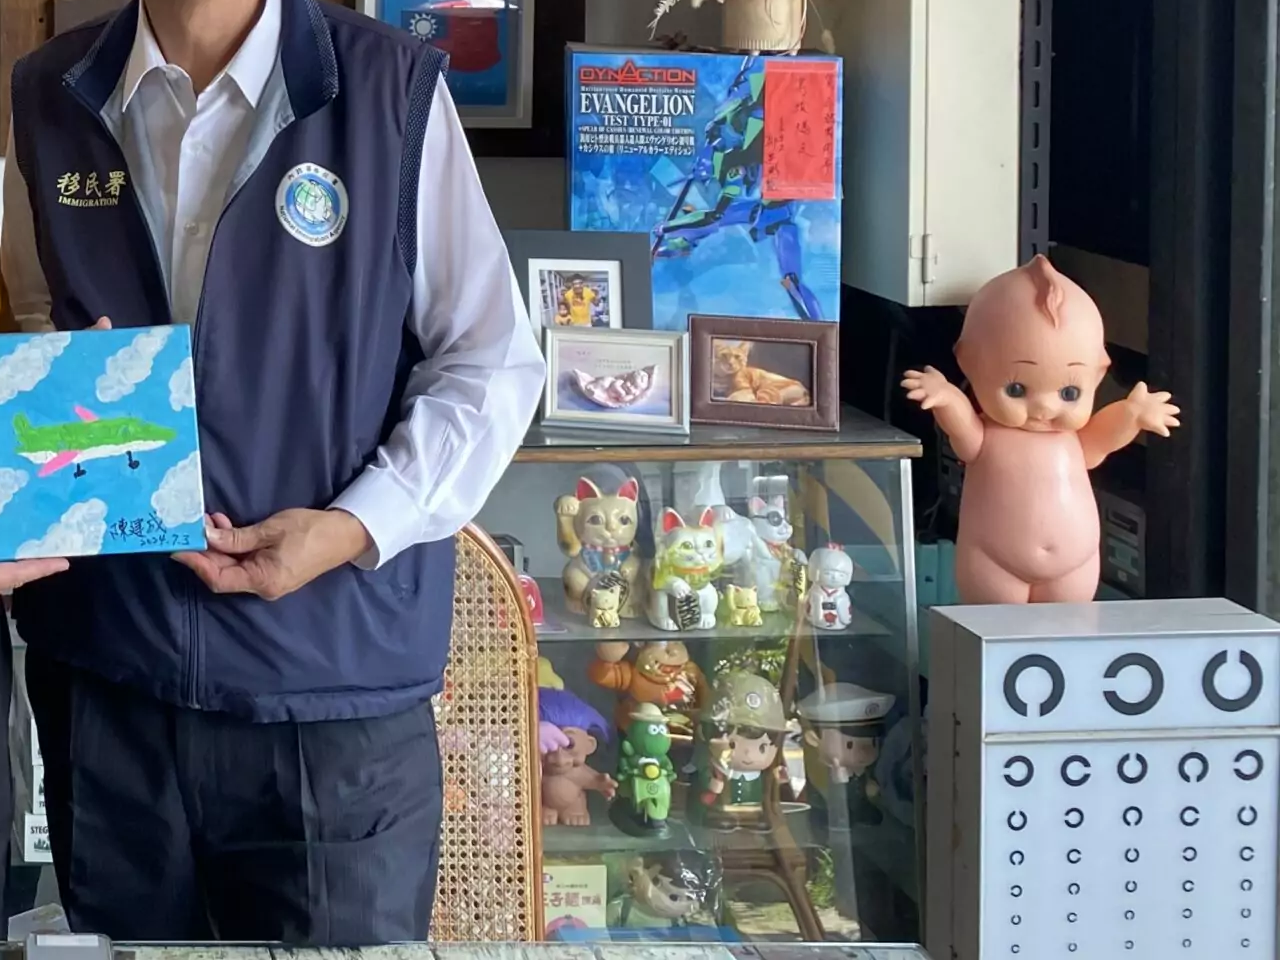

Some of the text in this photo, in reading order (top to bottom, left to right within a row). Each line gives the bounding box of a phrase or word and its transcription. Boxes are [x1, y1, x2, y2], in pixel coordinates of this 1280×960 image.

[579, 58, 697, 84] DYNACTION
[580, 93, 696, 116] EVANGELION
[603, 115, 629, 126] TEST
[56, 170, 127, 198] 移民署
[58, 195, 120, 208] IMMIGRATION
